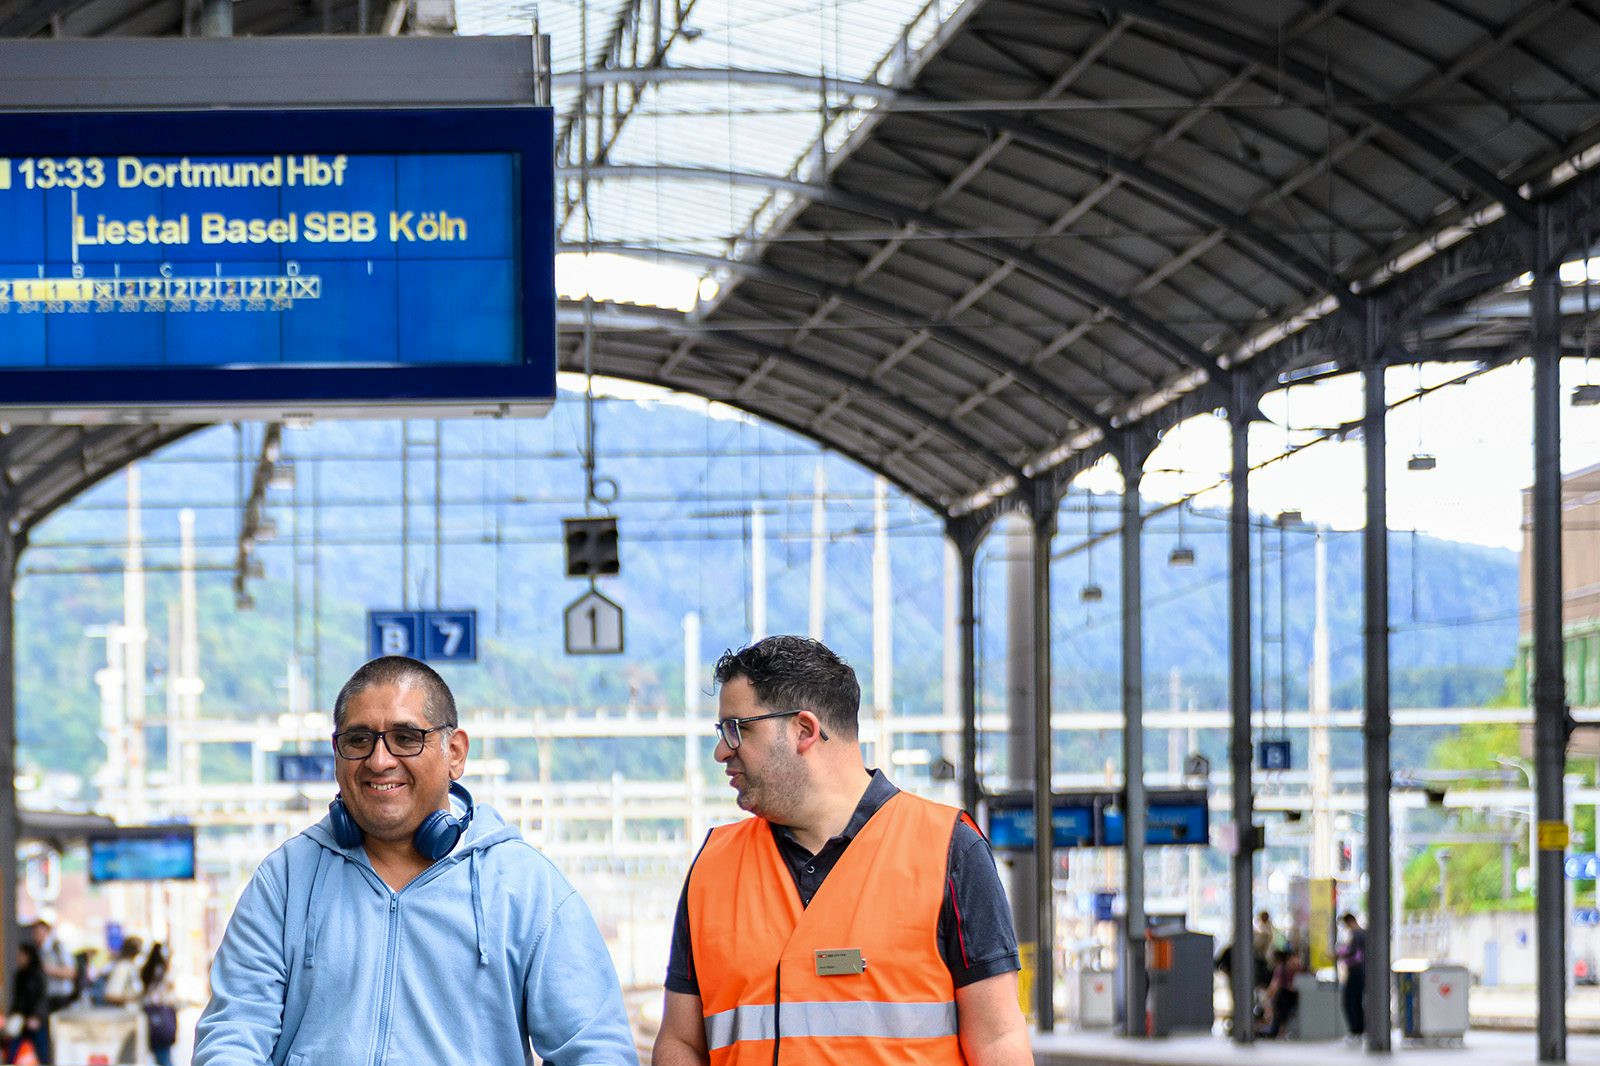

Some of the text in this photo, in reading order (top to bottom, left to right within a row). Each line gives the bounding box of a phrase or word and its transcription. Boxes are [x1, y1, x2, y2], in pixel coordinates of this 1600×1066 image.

[18, 157, 106, 189] 13:33
[117, 155, 282, 189] Dortmund
[286, 154, 348, 187] Hbf
[76, 210, 468, 246] Liestal Basel SBB Köln
[160, 262, 173, 279] C
[381, 621, 464, 657] B 7
[585, 607, 597, 647] 1
